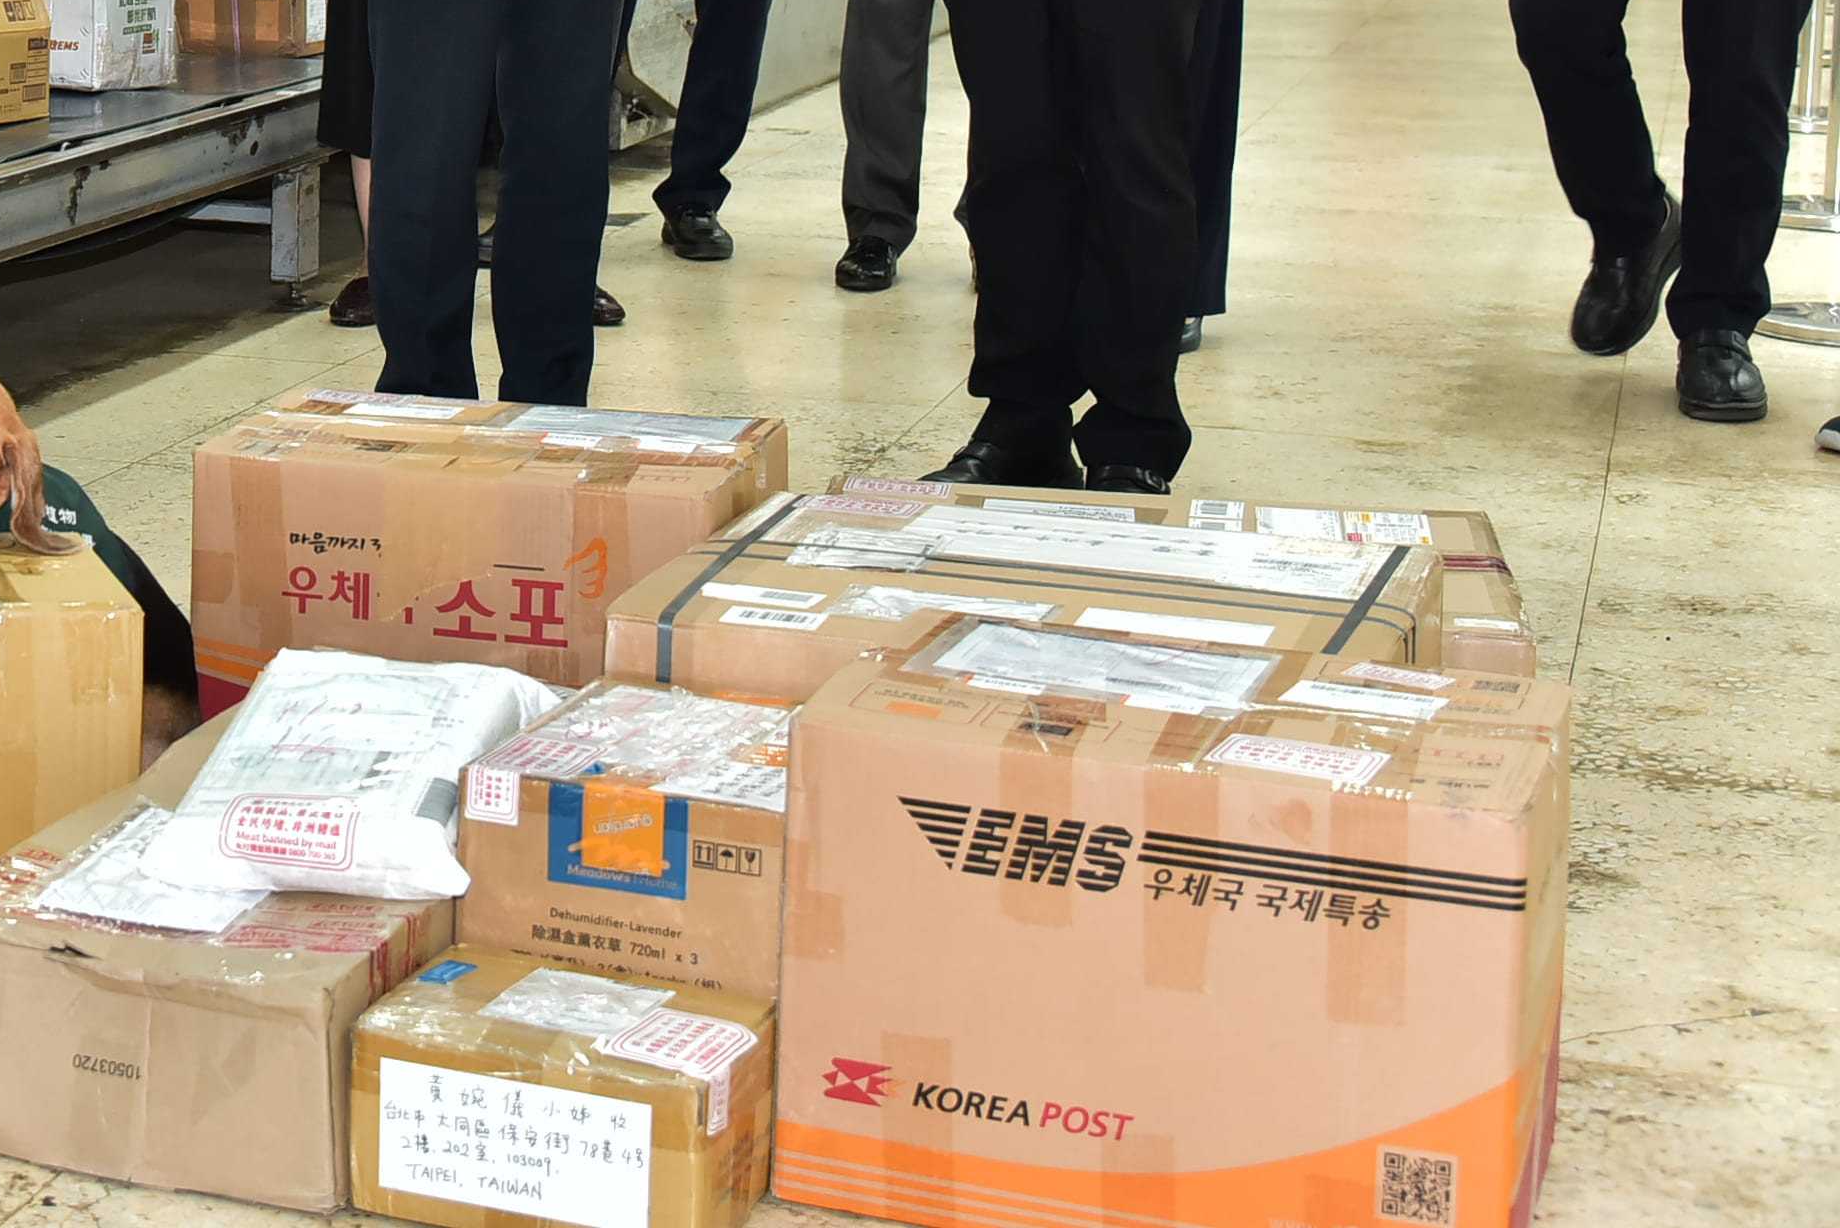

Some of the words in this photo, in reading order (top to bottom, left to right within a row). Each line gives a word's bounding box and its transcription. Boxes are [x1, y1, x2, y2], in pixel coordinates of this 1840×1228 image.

[289, 532, 365, 554] 마음까지
[432, 578, 568, 648] 소포
[236, 830, 260, 842] Meat
[262, 832, 299, 846] banned
[301, 838, 313, 849] by
[315, 841, 337, 850] mail
[960, 808, 1133, 893] EMS
[567, 863, 630, 884] Meadows
[1143, 868, 1244, 910] 우체국
[1254, 883, 1392, 931] 국제특송
[549, 906, 683, 940] Dehumidifier-Lavender
[629, 941, 666, 961] 720ml
[675, 954, 683, 963] x
[690, 952, 699, 966] 3
[72, 1053, 142, 1080] 10503720
[912, 1082, 1030, 1127] KOREA
[1039, 1101, 1134, 1141] POST
[478, 1176, 543, 1201] TAIWAN
